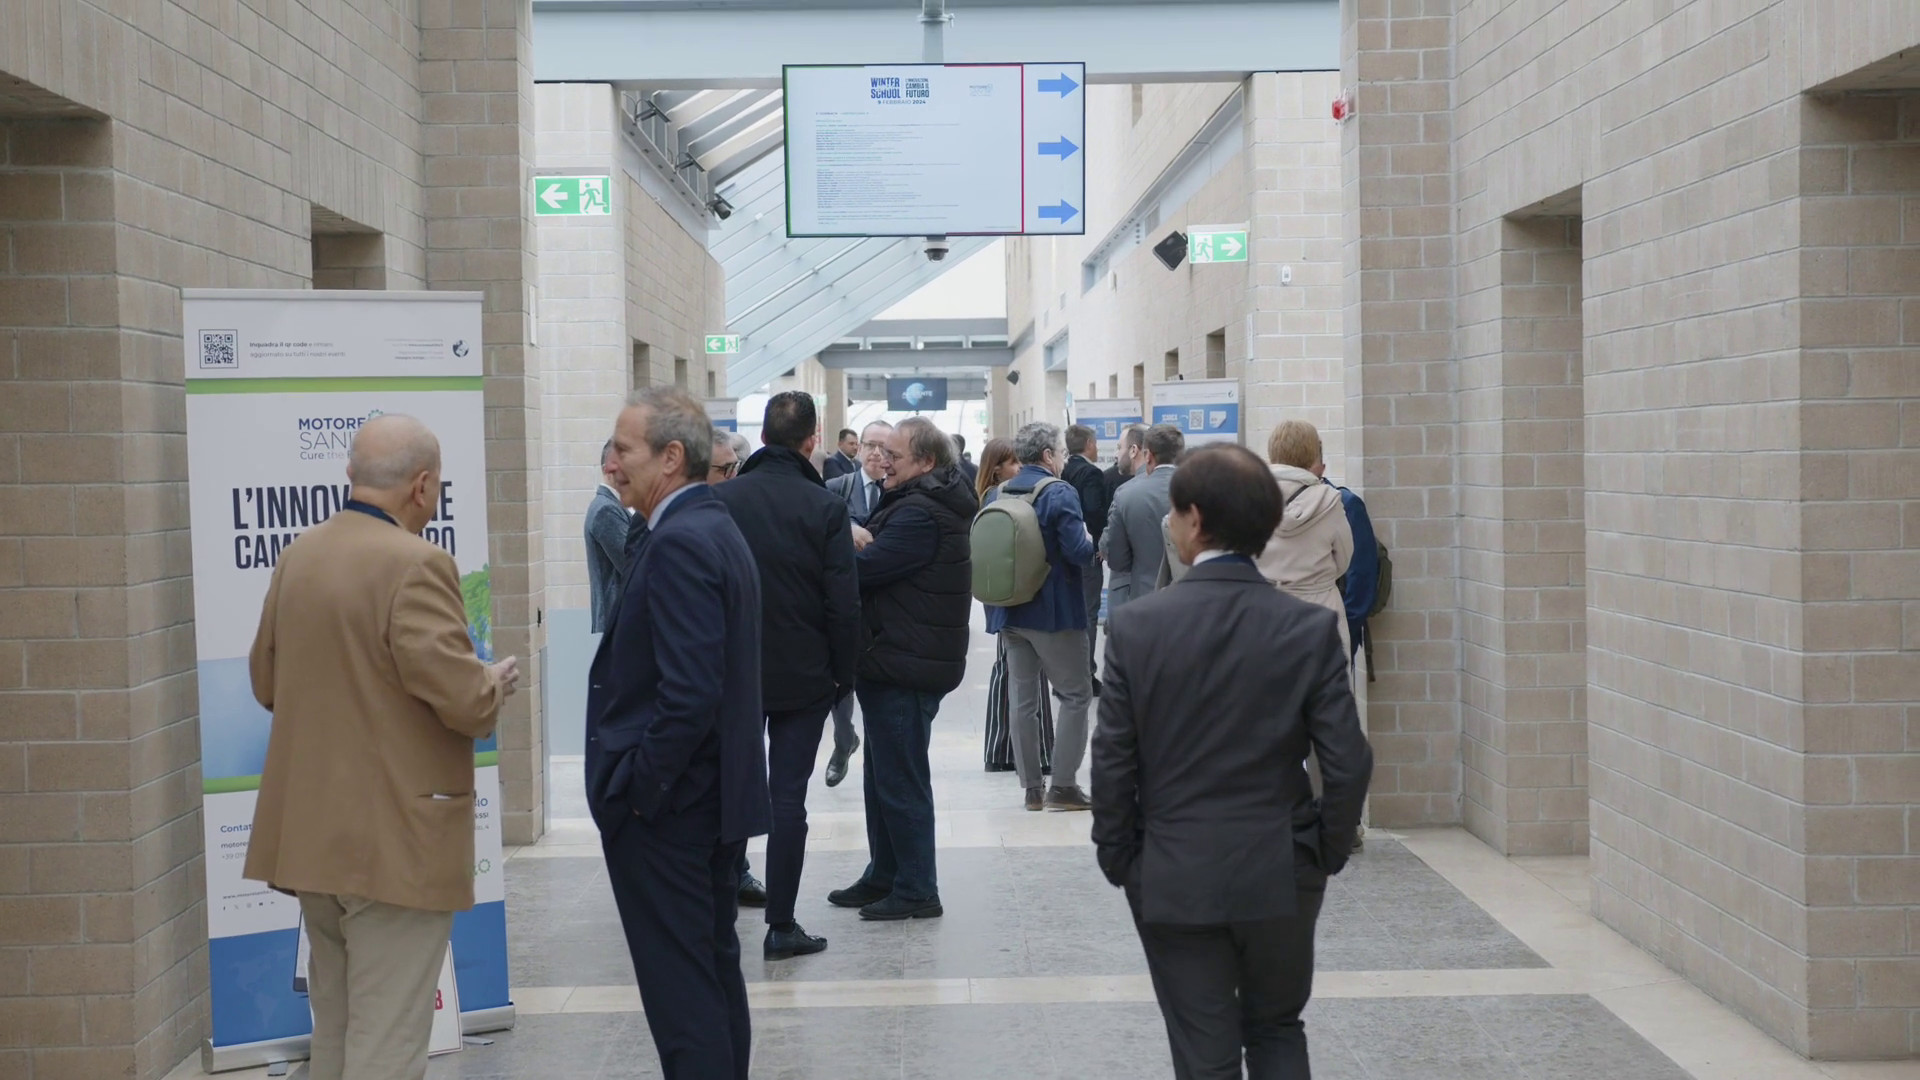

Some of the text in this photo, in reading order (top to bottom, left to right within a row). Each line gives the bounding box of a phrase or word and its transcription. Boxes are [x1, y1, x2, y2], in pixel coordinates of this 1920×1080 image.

[870, 77, 900, 88] WINTER
[870, 89, 901, 99] SCHOOL
[905, 90, 930, 98] FUTURO
[299, 431, 357, 450] SANI
[299, 451, 325, 460] Cure
